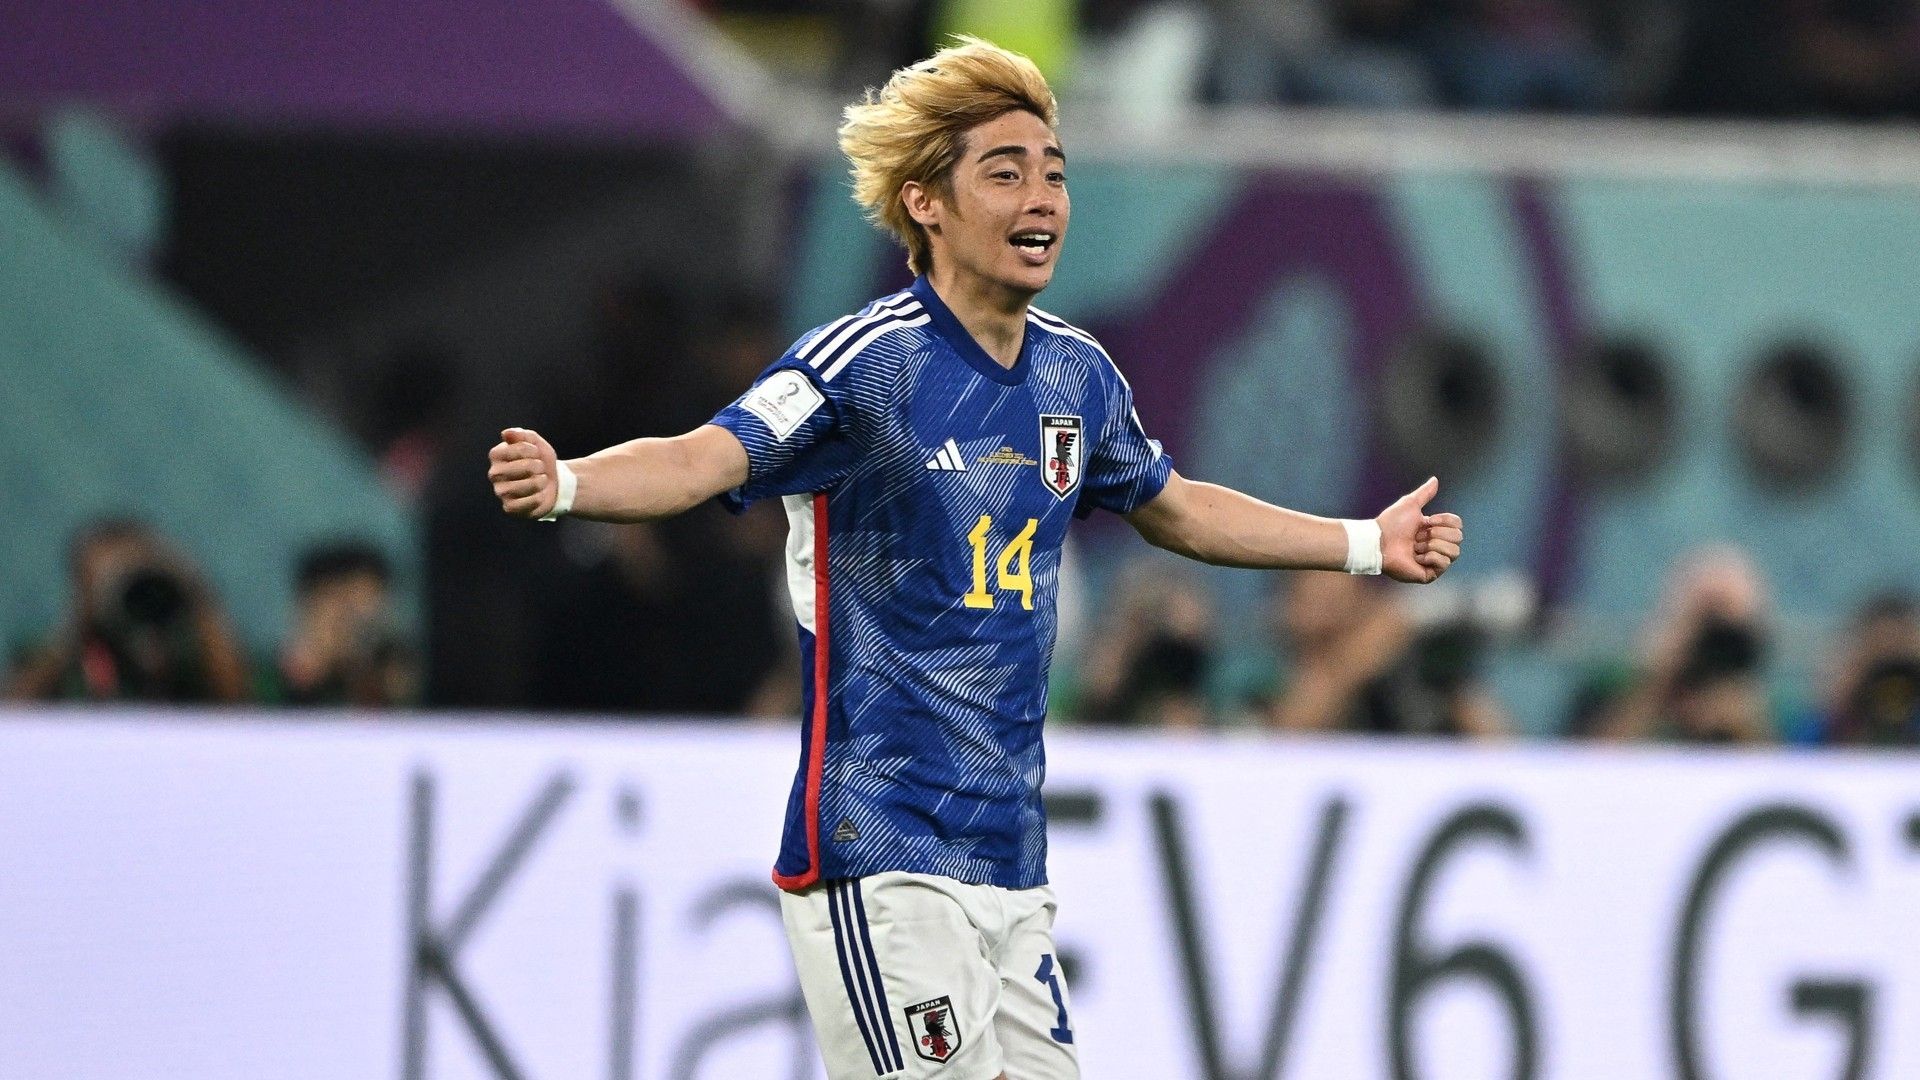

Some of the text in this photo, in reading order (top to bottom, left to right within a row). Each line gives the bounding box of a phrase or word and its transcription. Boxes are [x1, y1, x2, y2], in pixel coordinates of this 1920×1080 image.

[1051, 418, 1073, 426] JAPAN
[964, 515, 1038, 610] 14
[402, 768, 1920, 1080] Kia V6 G
[916, 1000, 941, 1012] JAPAN
